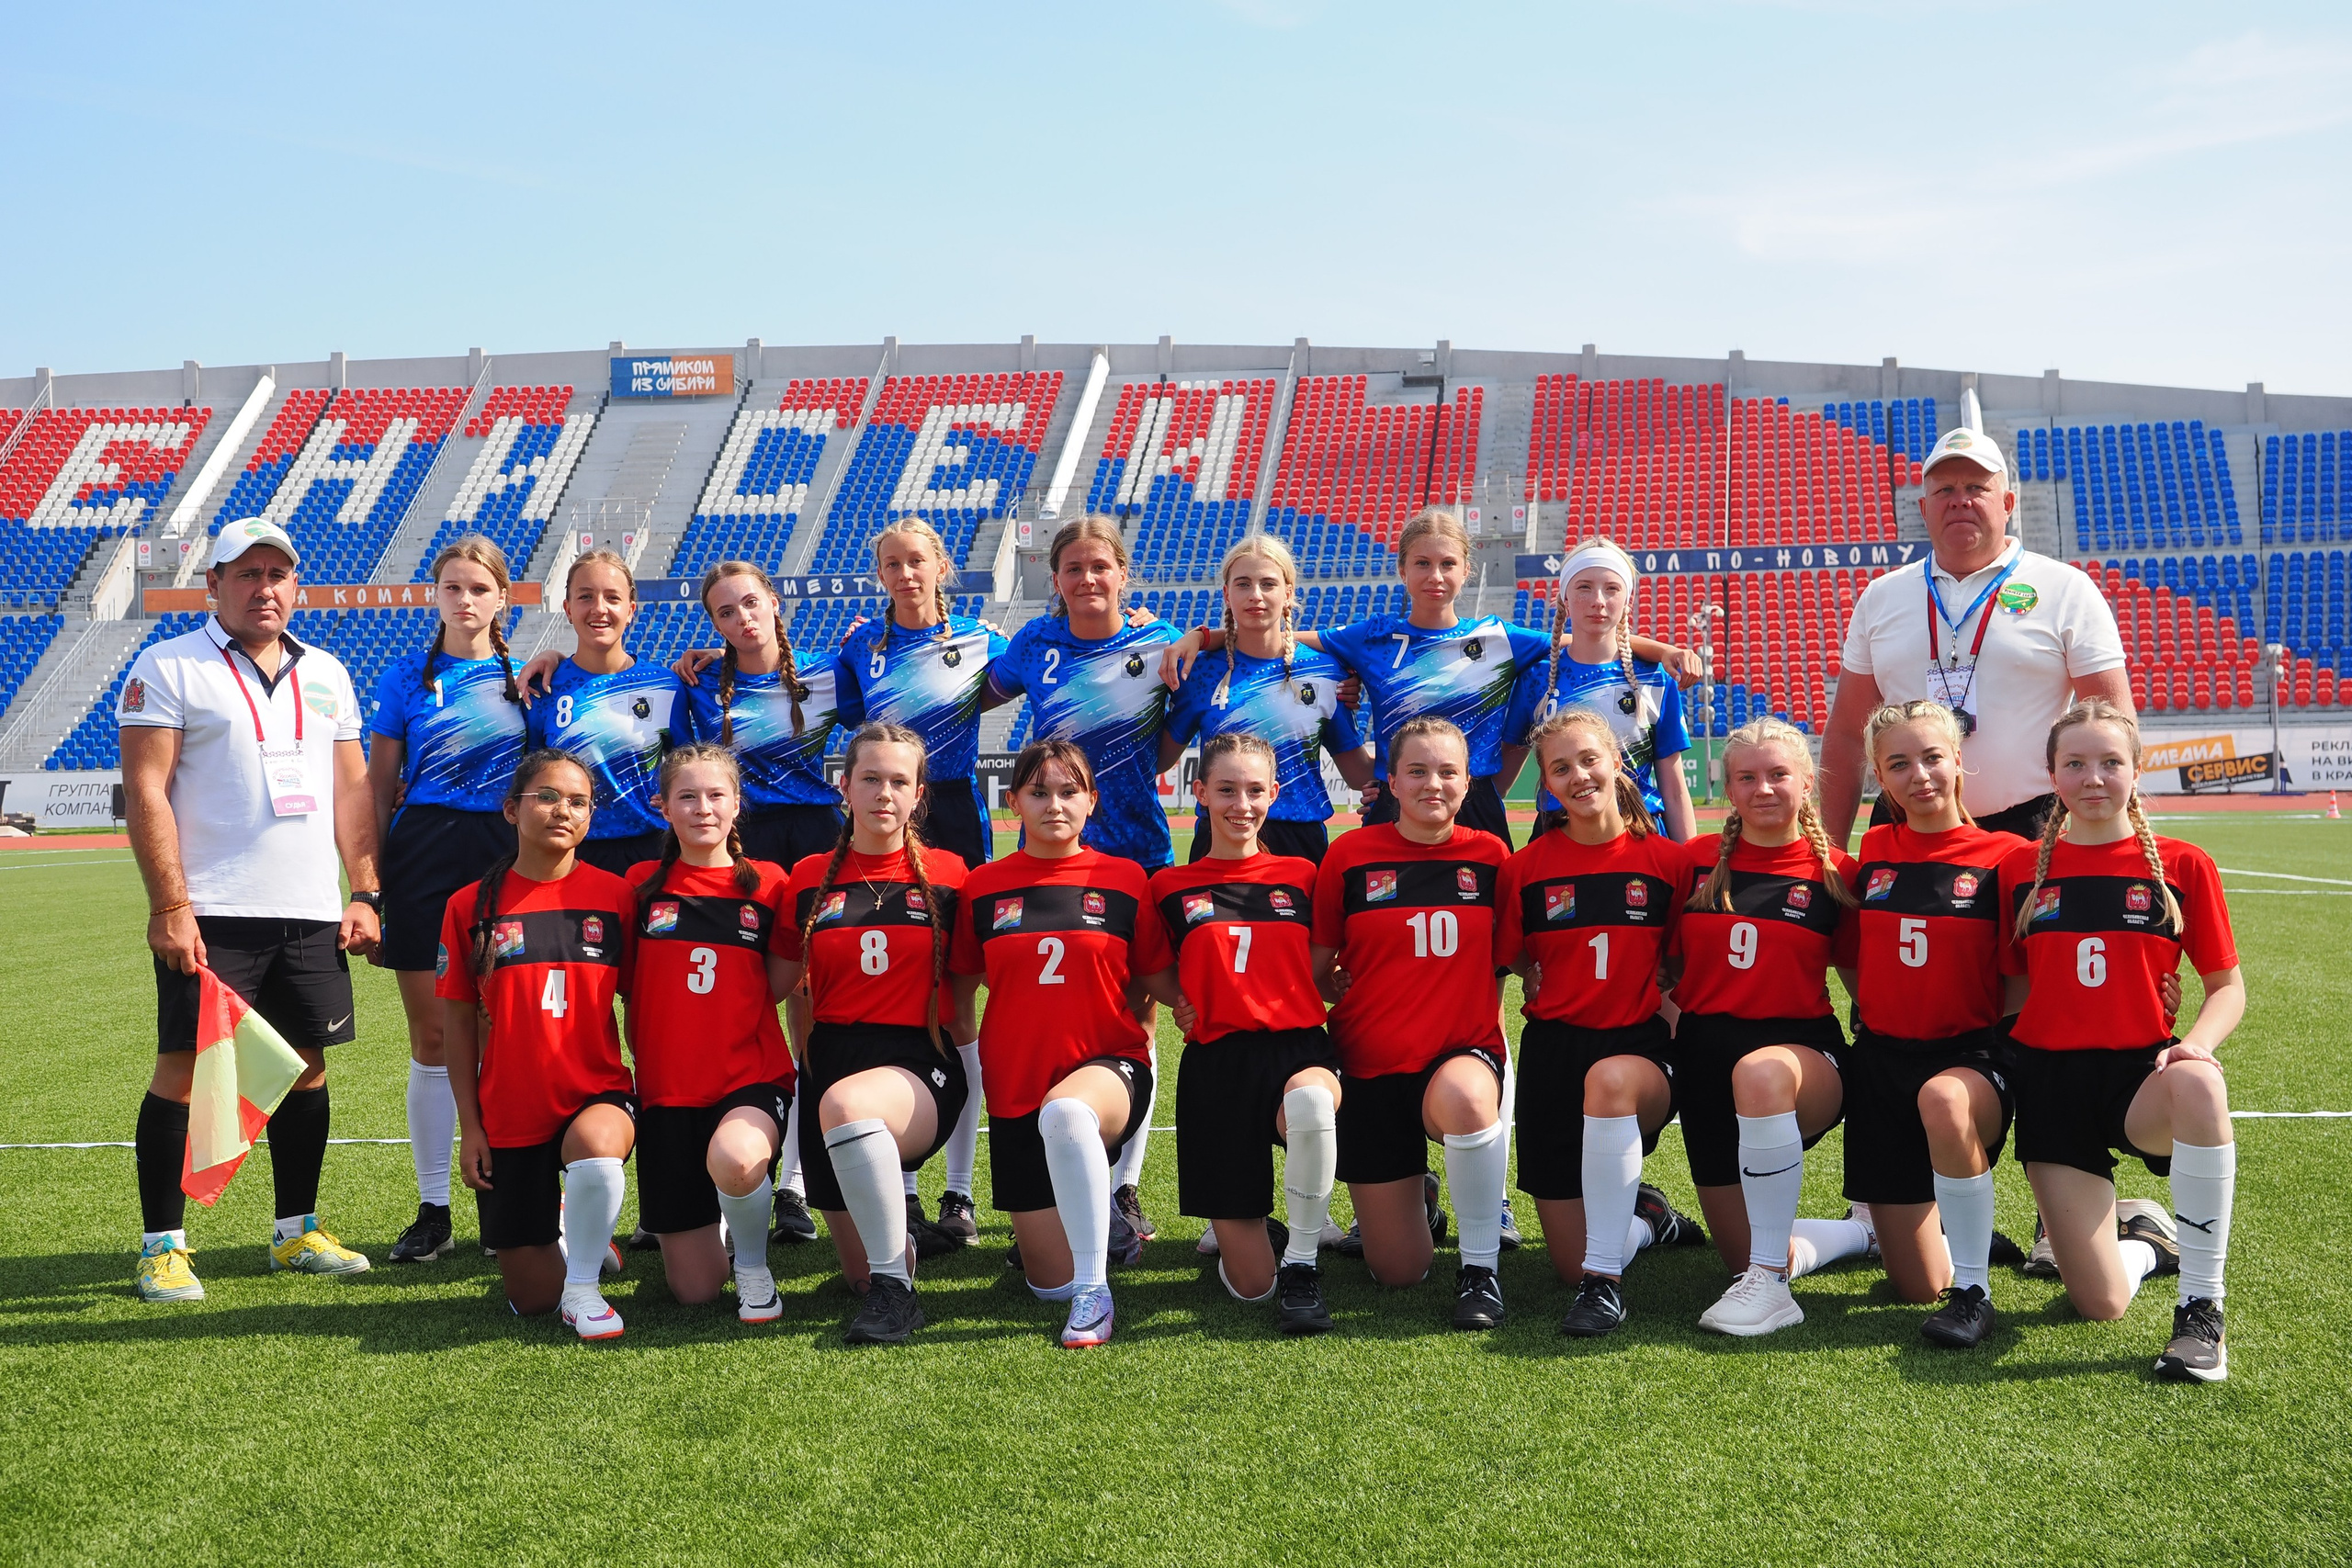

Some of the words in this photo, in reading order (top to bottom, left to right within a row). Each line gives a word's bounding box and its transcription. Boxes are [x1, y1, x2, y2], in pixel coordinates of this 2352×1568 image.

[631, 378, 653, 391] ИЗ
[656, 376, 715, 391] СИБИРИ
[632, 360, 715, 376] ПРЯМИКОМ
[1707, 544, 1915, 570] ПО-НОВОМУ
[334, 587, 435, 604] КОМАН
[869, 646, 887, 679] 5
[1042, 649, 1060, 684] 2
[1392, 633, 1410, 669] 7
[434, 679, 444, 707] 1
[556, 694, 574, 728] 8
[2146, 742, 2223, 768] МЕДИА
[2312, 740, 2352, 751] РЕКЛ
[2312, 756, 2333, 766] НА
[2187, 756, 2267, 783] СЕРВИС
[49, 784, 110, 797] ГРУППА
[44, 802, 112, 817] КОМПАН
[1228, 926, 1251, 973] 7
[1407, 910, 1459, 957] 10
[1727, 921, 1758, 969] 9
[1899, 917, 1928, 967] 5
[860, 930, 889, 976] 8
[1037, 937, 1065, 985] 2
[1588, 932, 1609, 980] 1
[2076, 937, 2107, 987] 6
[687, 947, 718, 994] 3
[541, 969, 568, 1018] 4
[931, 1067, 946, 1088] 8
